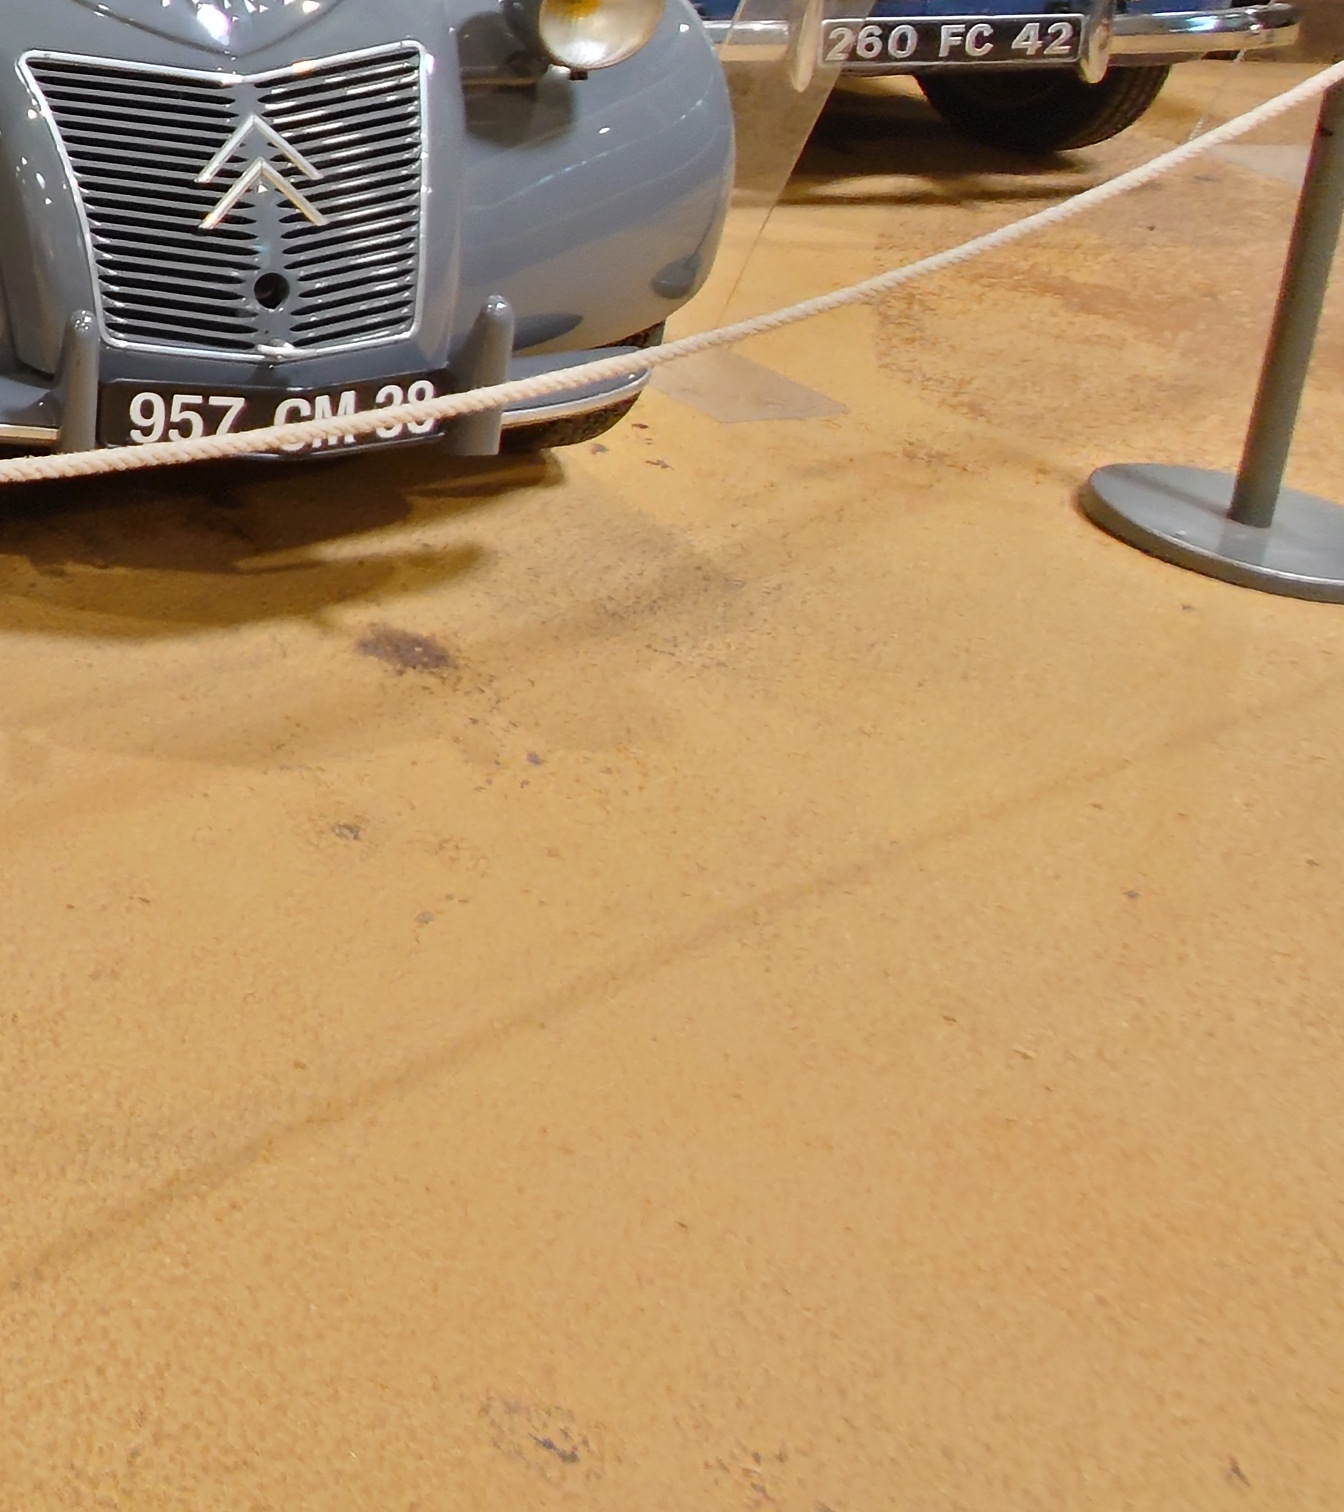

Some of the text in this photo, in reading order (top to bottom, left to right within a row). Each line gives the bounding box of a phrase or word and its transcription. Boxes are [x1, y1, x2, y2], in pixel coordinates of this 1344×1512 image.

[825, 22, 1074, 61] 260 FC 42
[129, 391, 246, 444] 957
